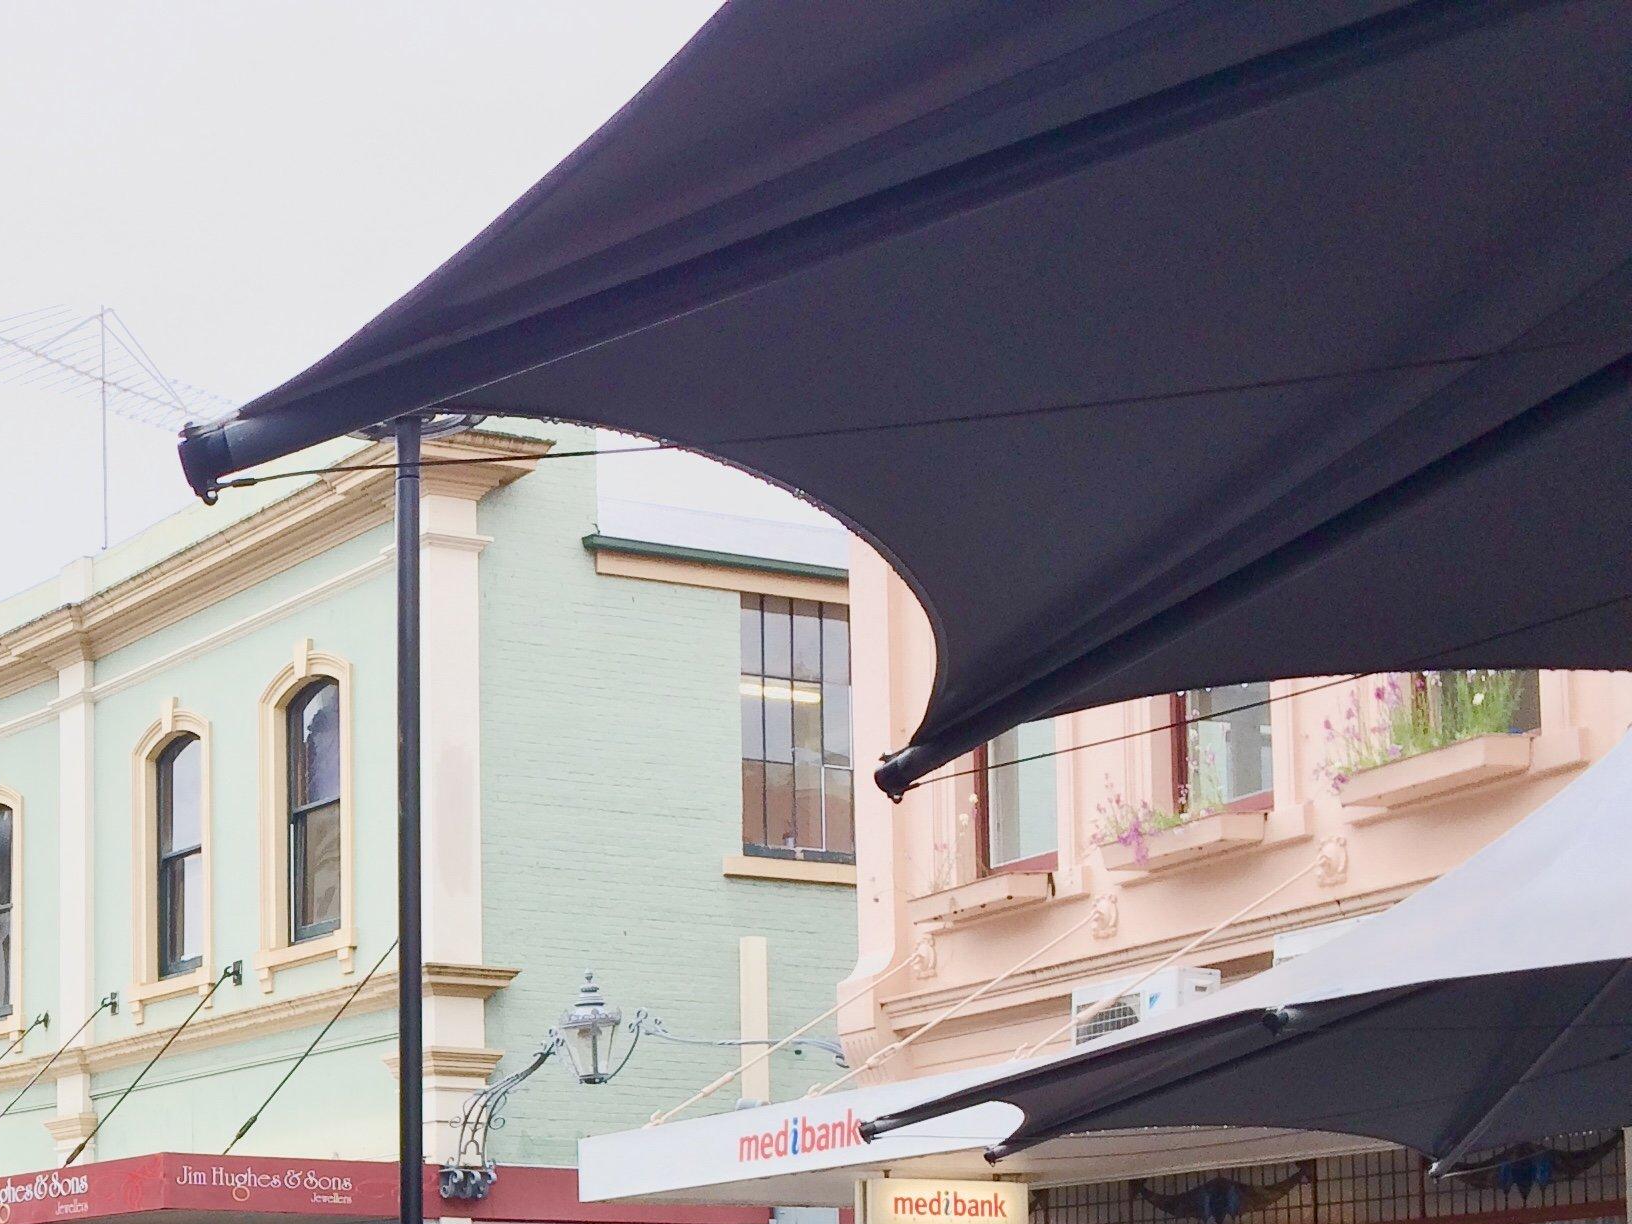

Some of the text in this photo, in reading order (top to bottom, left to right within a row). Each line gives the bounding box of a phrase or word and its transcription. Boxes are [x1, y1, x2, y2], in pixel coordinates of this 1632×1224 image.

[739, 1108, 863, 1162] medibank
[33, 1174, 49, 1200] &
[49, 1171, 89, 1198] Sons
[176, 1165, 353, 1201] Jim Hughes & Sons
[310, 1192, 353, 1205] Jewellers
[893, 1190, 1008, 1218] medibank
